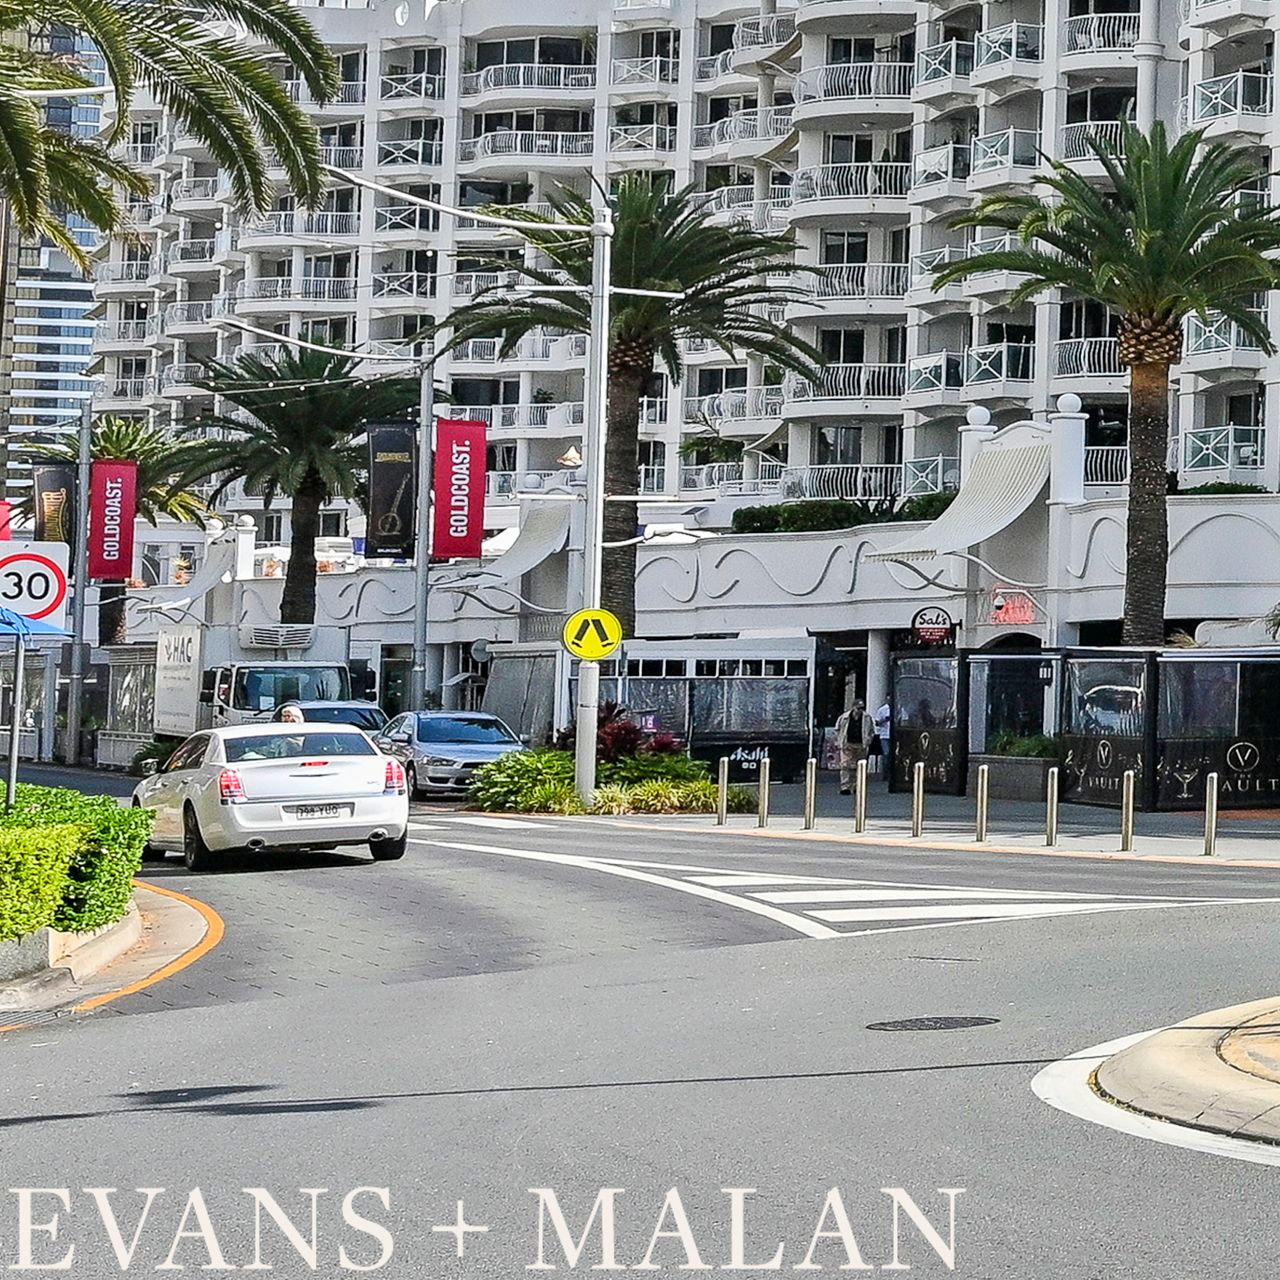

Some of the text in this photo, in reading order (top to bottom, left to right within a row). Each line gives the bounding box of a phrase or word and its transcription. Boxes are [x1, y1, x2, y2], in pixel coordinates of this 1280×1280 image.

[1, 571, 51, 601] 30
[918, 612, 948, 626] Sal's
[729, 746, 770, 762] Asahi
[1221, 778, 1280, 793] AULT
